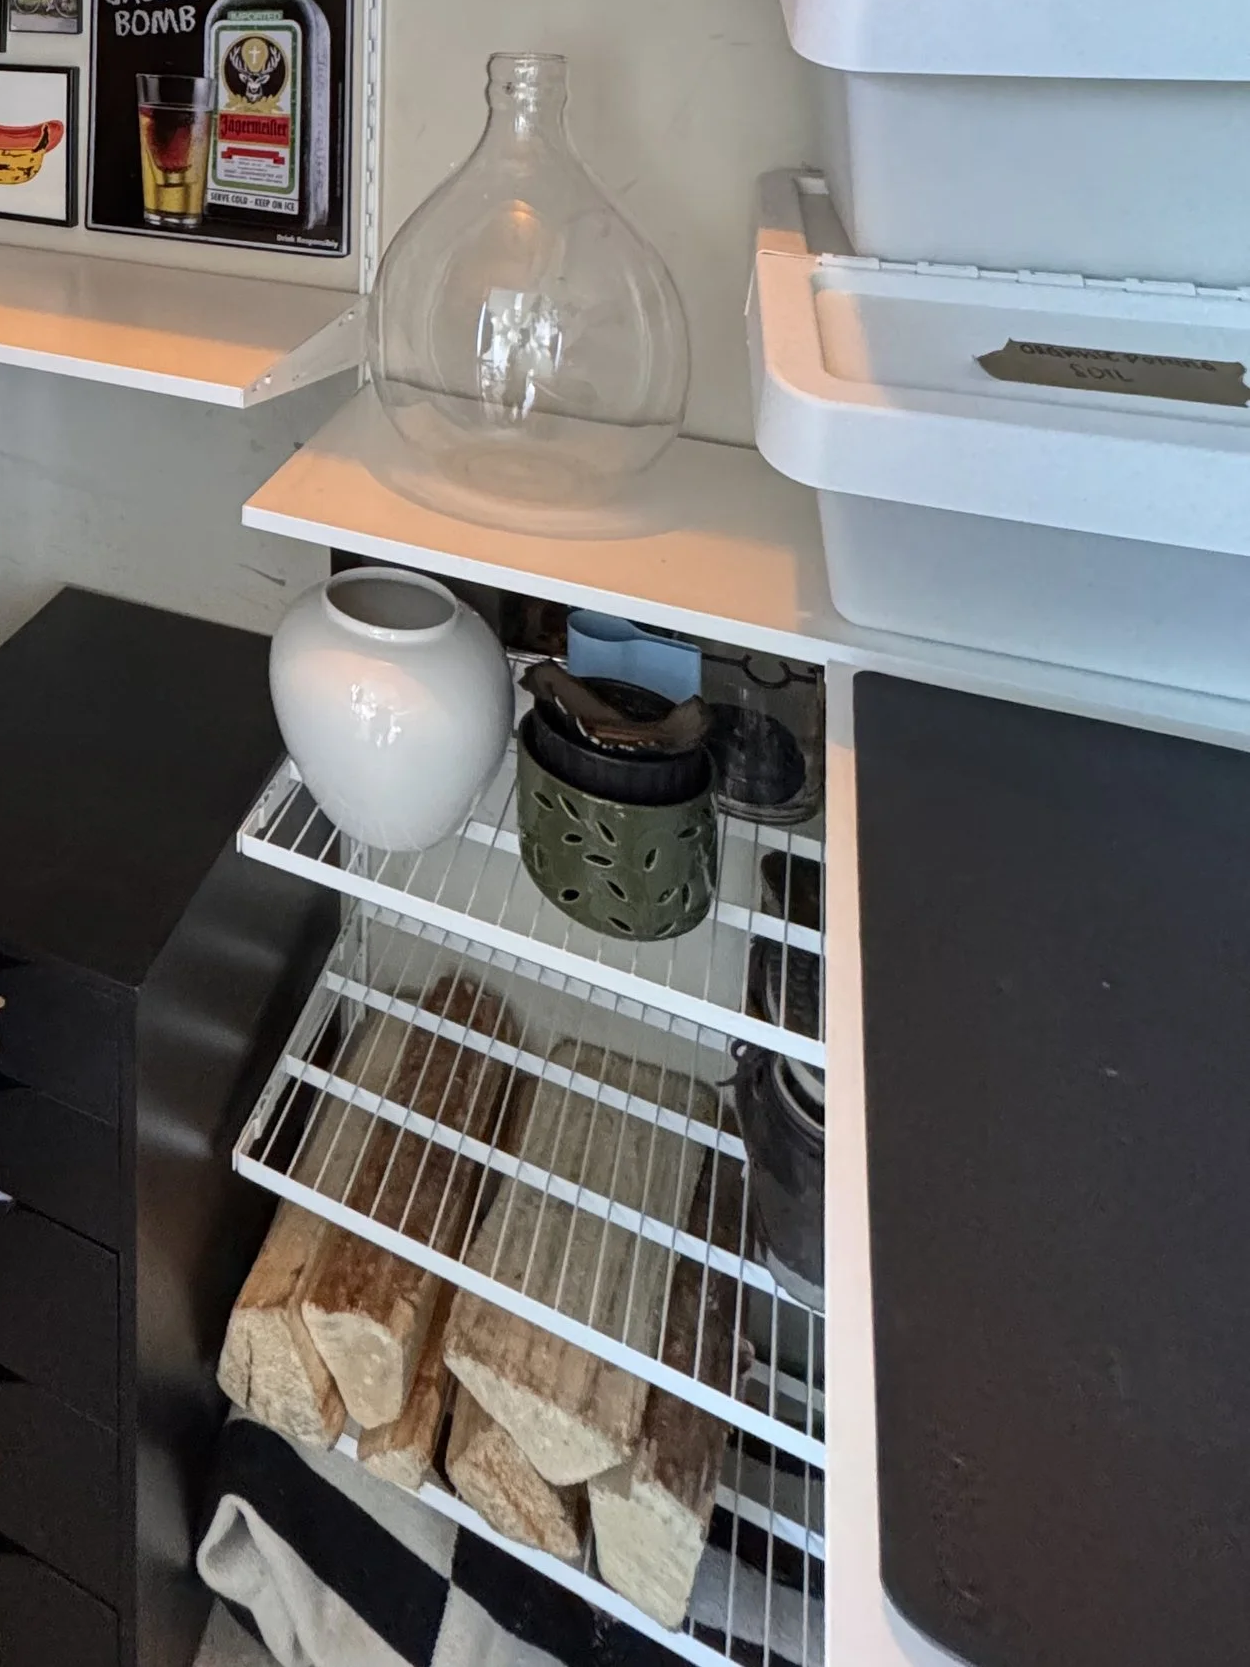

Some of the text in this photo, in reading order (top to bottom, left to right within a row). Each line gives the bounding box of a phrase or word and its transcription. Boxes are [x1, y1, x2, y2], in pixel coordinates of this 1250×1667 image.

[115, 5, 196, 36] BOMB
[211, 193, 229, 203] SERVE
[232, 194, 248, 205] COLD
[254, 197, 271, 208] KEEP
[272, 199, 283, 209] ON
[284, 201, 295, 212] ICE
[1069, 362, 1134, 383] SOIL
